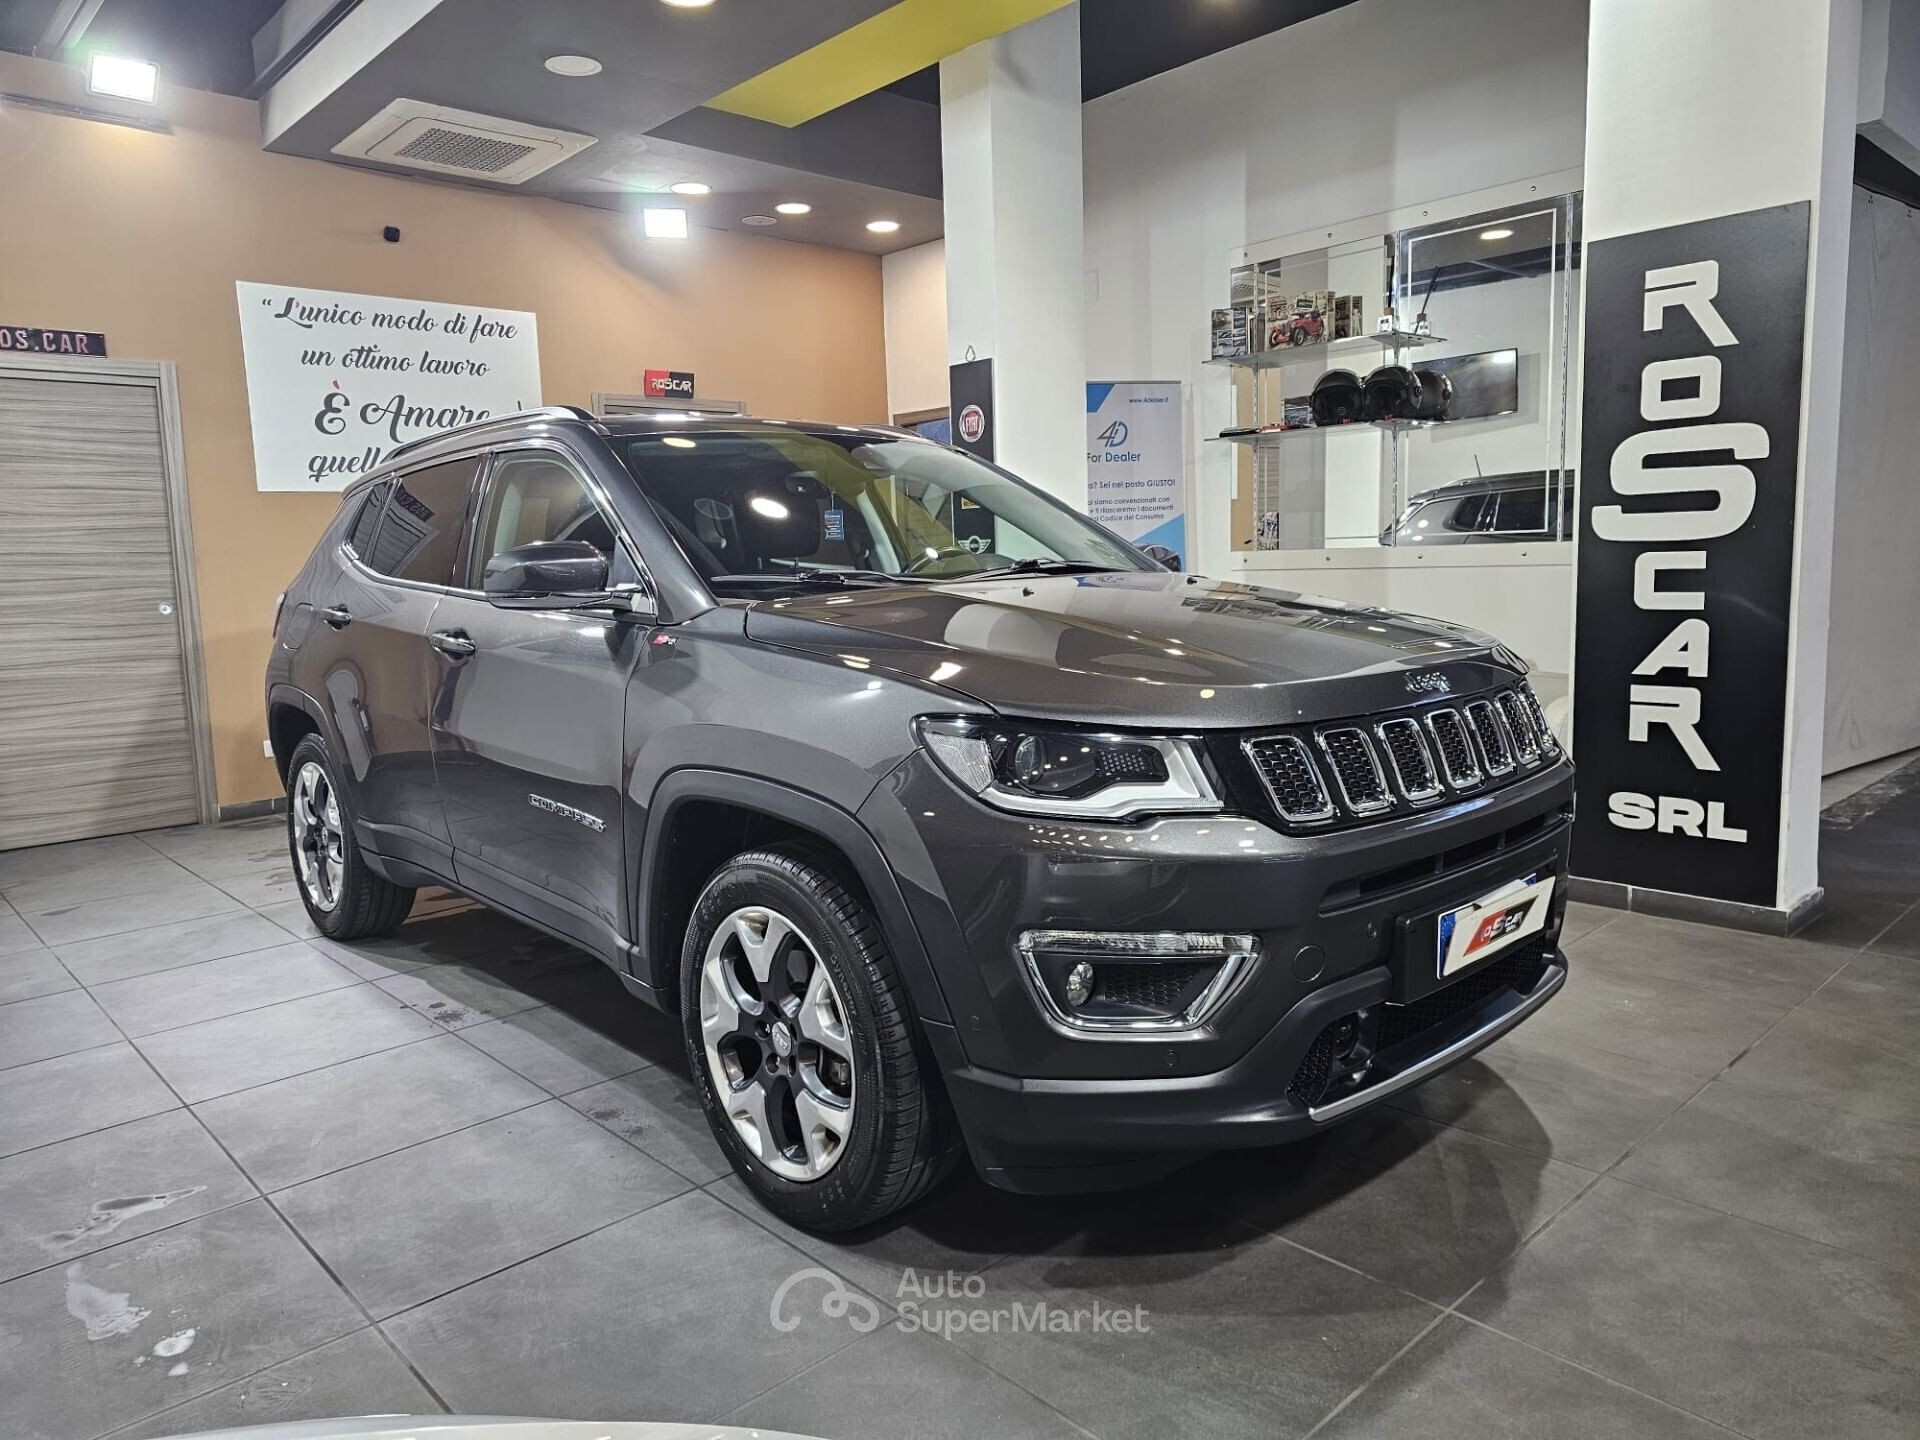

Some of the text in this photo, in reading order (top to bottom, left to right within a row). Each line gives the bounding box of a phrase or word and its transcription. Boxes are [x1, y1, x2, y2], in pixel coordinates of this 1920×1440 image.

[274, 297, 366, 329] L'unico
[371, 309, 438, 332] modo
[444, 312, 468, 335] di
[469, 314, 518, 343] fare
[0, 328, 89, 354] OS.CAR
[301, 344, 491, 376] un ottimo lavoro
[651, 378, 692, 393] ROSCAR
[314, 380, 350, 435] È
[965, 415, 979, 433] FIAT
[308, 447, 381, 483] quell
[1105, 451, 1141, 462] Dealer
[1099, 481, 1111, 489] Sei
[1125, 480, 1145, 489] posto
[1146, 479, 1176, 487] GIUSTO!
[1608, 791, 1748, 843] SRL
